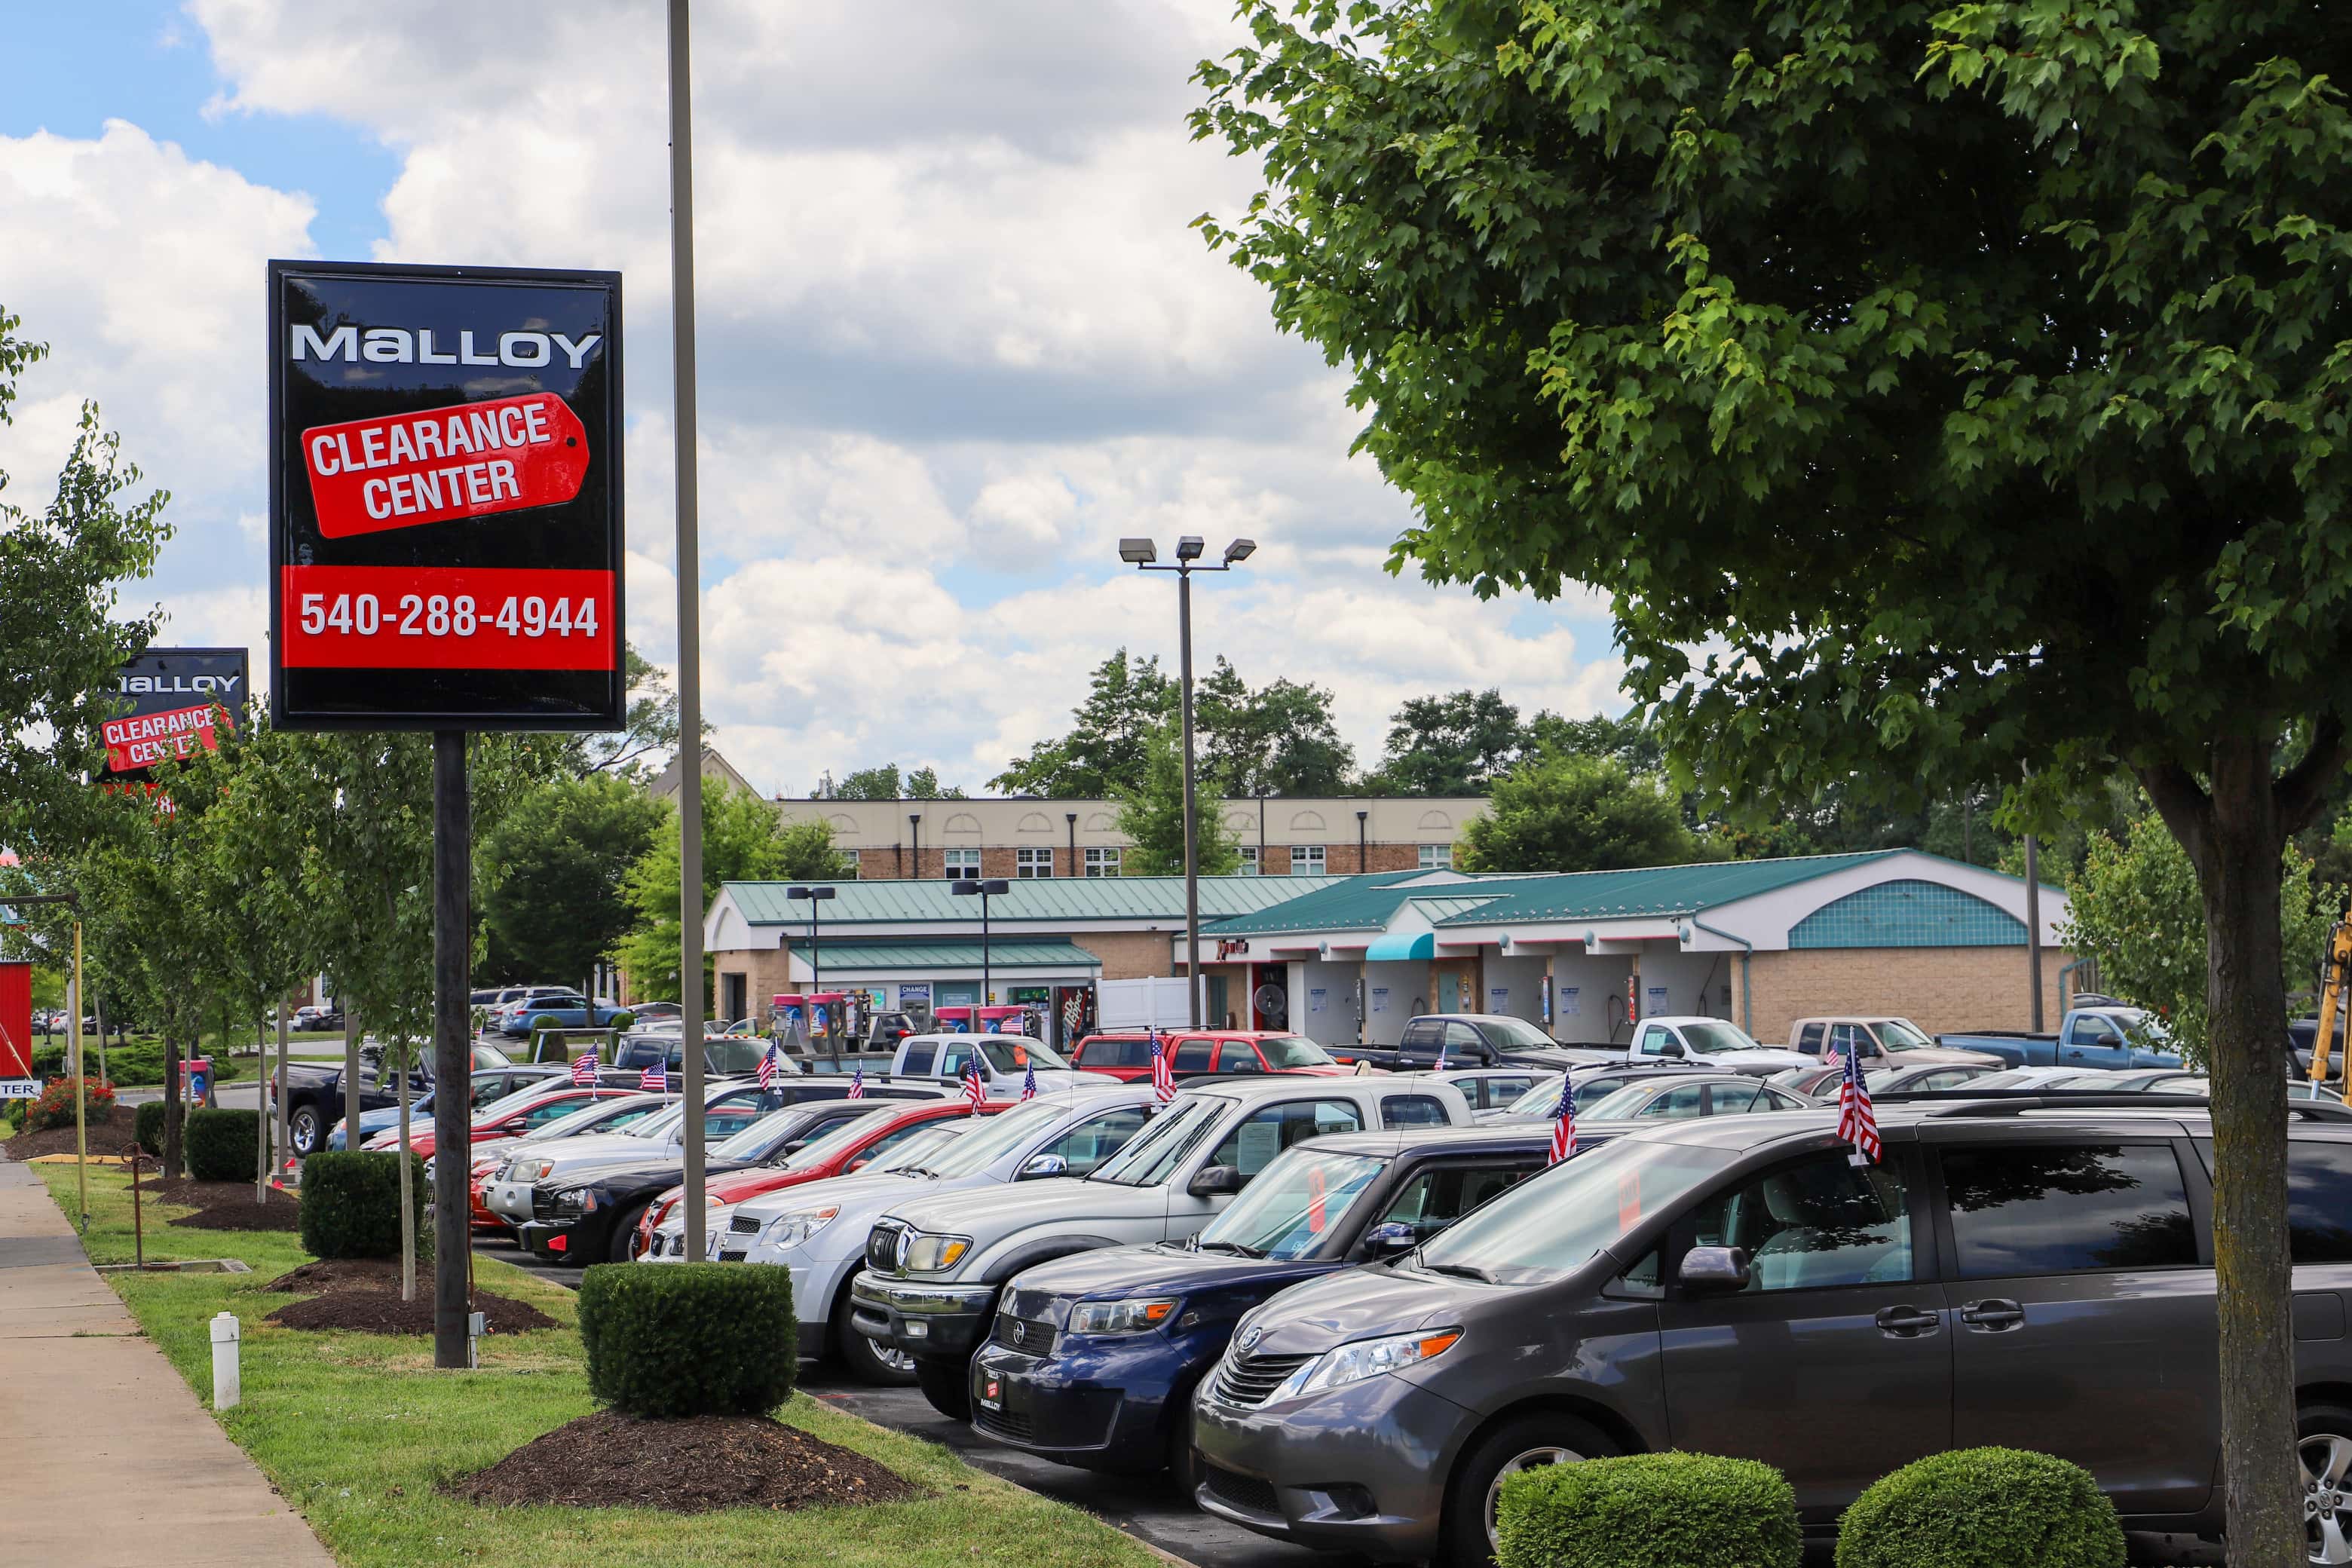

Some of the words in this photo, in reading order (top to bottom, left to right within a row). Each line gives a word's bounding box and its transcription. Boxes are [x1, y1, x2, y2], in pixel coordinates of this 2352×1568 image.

[311, 403, 551, 476] CLEARANCE
[363, 459, 521, 520] CENTER
[300, 593, 599, 637] 540-288-4944
